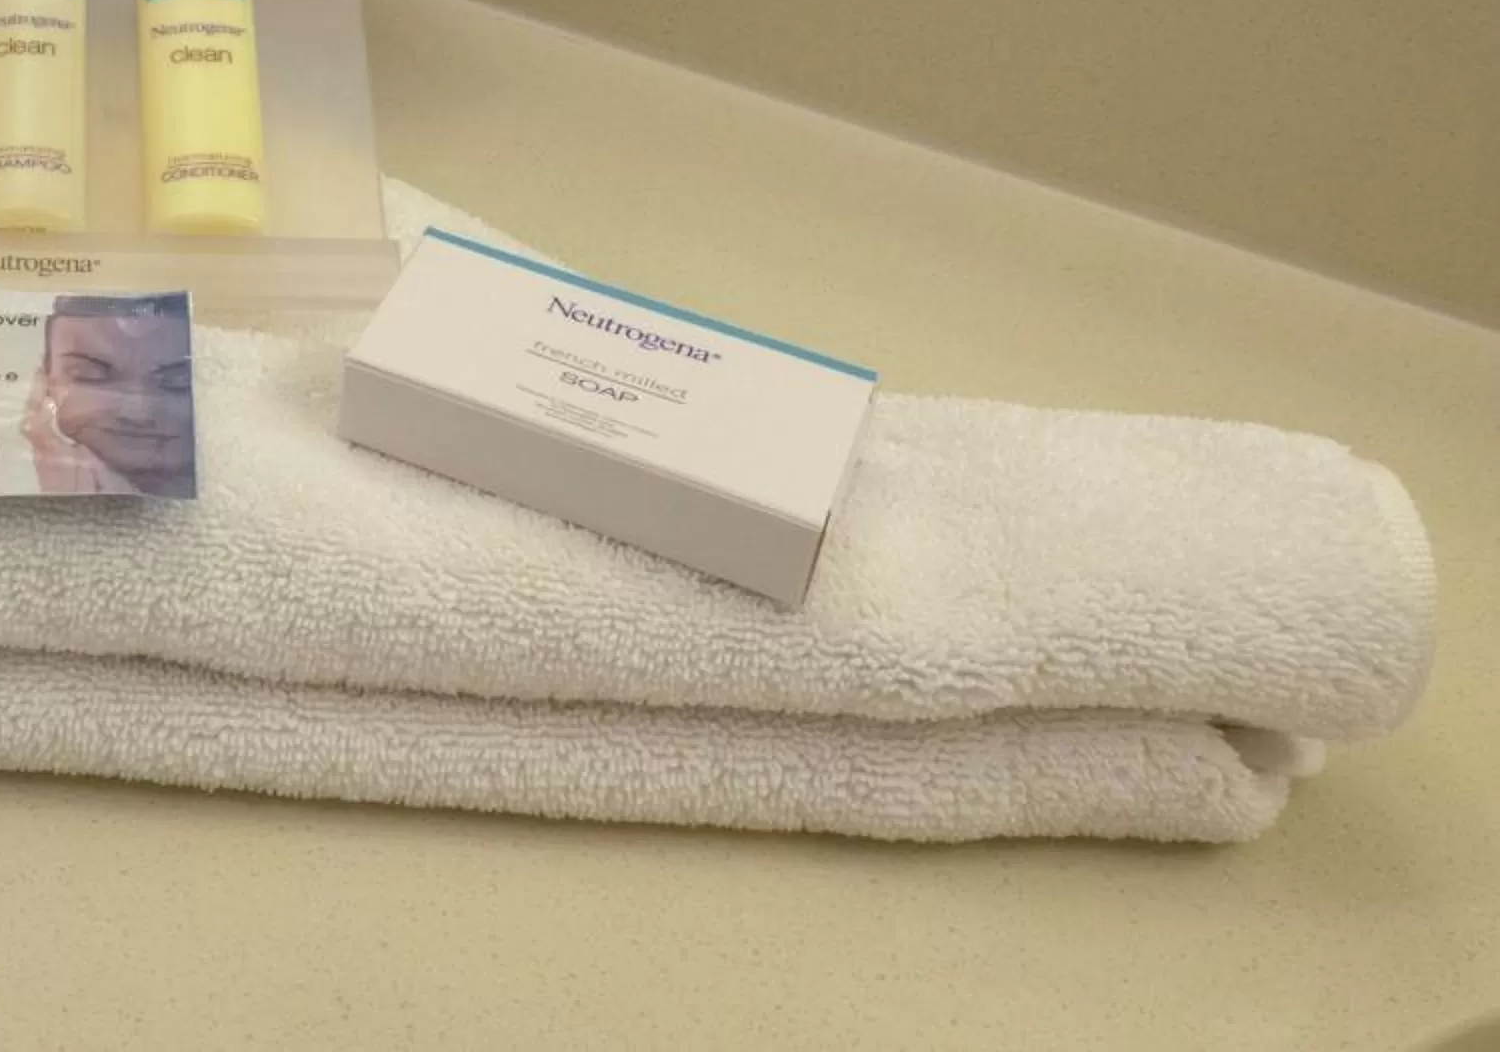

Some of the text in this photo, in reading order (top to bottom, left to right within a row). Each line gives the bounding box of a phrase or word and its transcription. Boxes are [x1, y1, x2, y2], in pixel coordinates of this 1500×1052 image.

[169, 44, 232, 64] clean
[533, 341, 688, 400] french milled
[559, 371, 639, 402] SOAP
